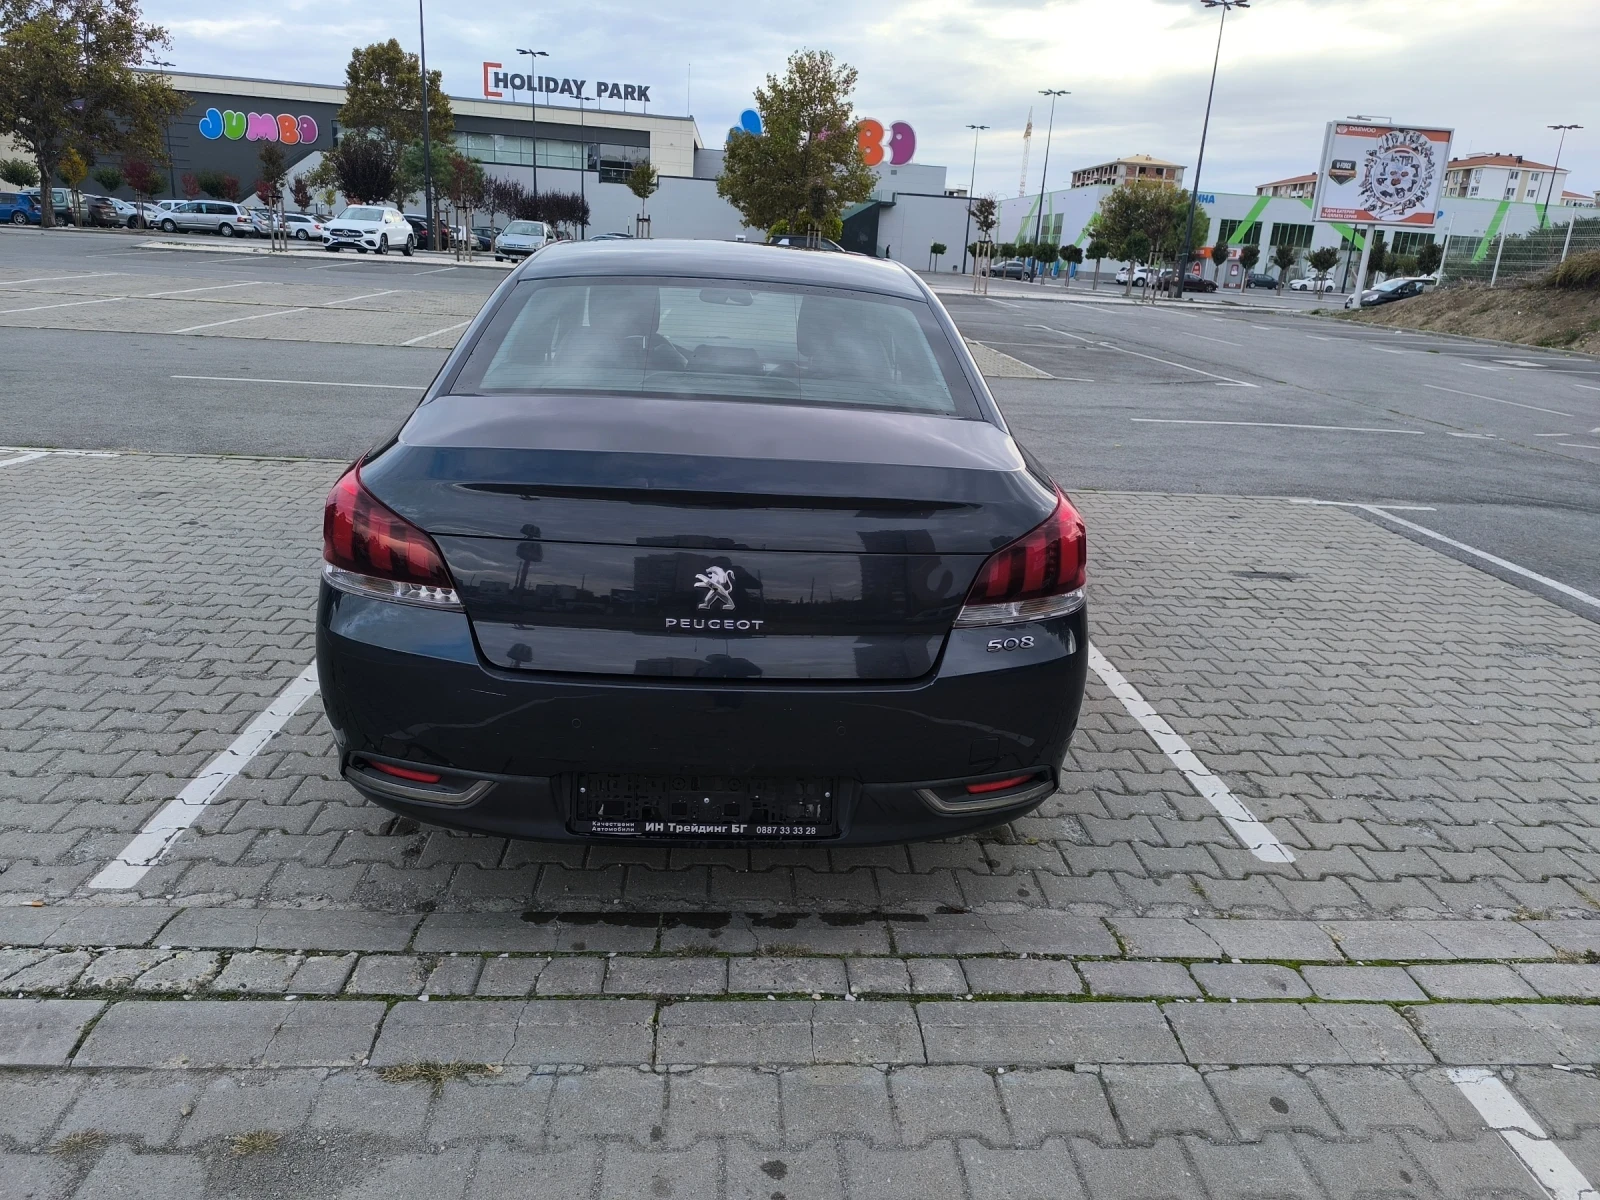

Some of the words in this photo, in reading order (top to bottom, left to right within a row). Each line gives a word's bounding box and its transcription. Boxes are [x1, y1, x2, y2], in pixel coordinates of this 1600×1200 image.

[493, 72, 587, 96] HOLIDAY
[596, 81, 651, 102] PARK
[198, 107, 319, 145] JUMBO
[1348, 125, 1377, 133] DAEWOO
[665, 618, 764, 630] PEUGEOT
[987, 635, 1035, 653] 508
[645, 822, 664, 832] ИН
[667, 822, 728, 834] Трейдинг
[731, 824, 748, 833] БГ
[756, 826, 777, 834] 0887
[779, 826, 791, 834] 33
[792, 826, 804, 835] 33
[805, 827, 816, 835] 28
